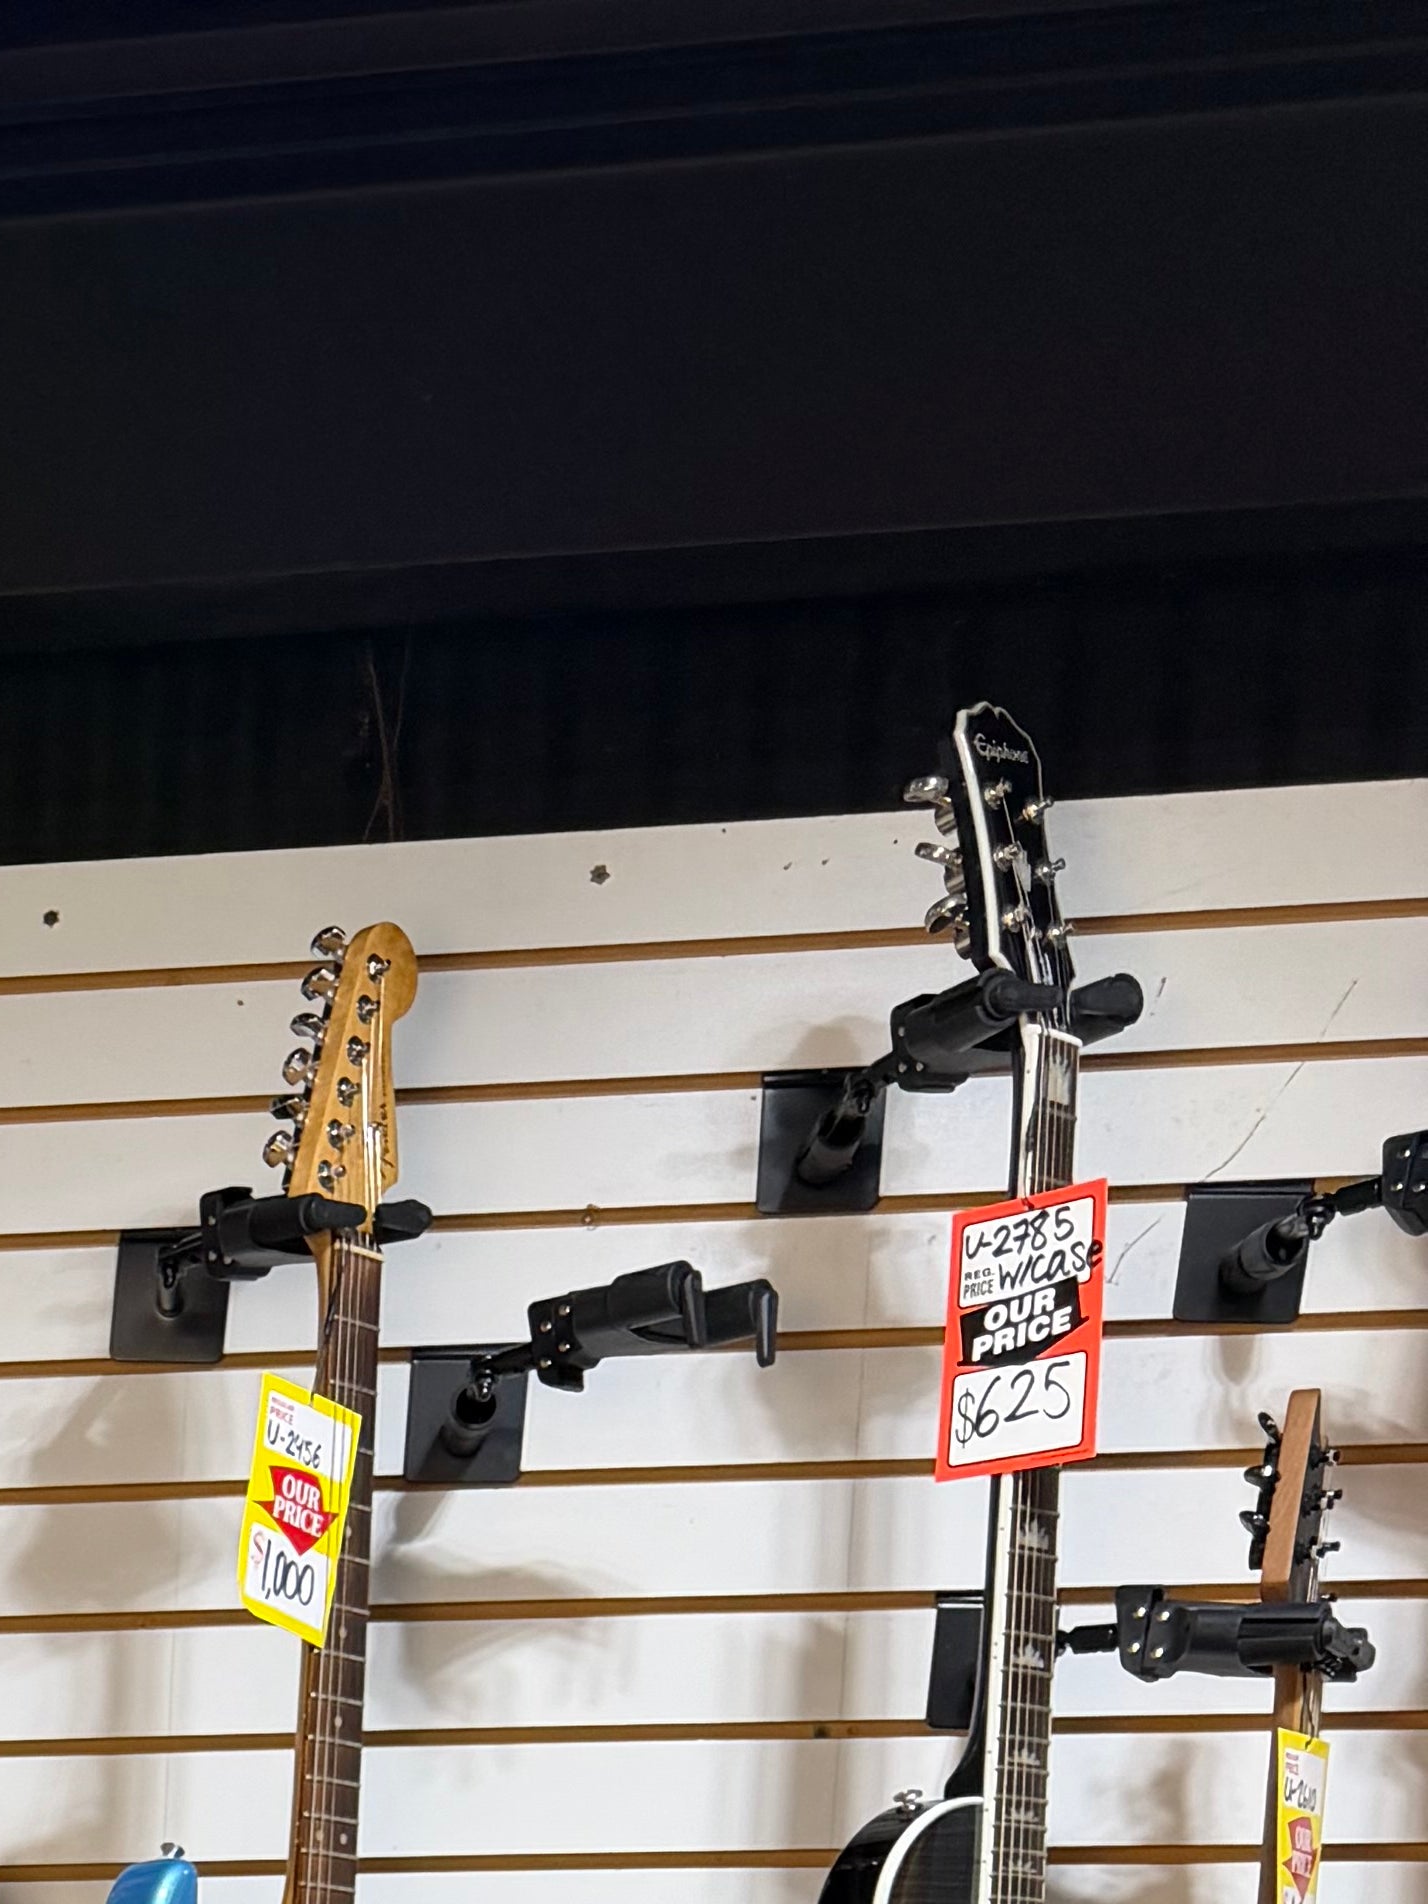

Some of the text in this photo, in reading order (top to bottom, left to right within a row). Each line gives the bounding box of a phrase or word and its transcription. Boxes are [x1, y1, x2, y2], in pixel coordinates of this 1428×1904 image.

[965, 1205, 1075, 1260] U-2785
[963, 1279, 994, 1300] PRICE
[964, 1266, 996, 1281] REG.
[983, 1287, 1056, 1331] OUR
[971, 1305, 1073, 1363] PRICE
[269, 1404, 295, 1425] PRICE
[955, 1360, 1072, 1449] $625
[281, 1474, 321, 1512] OUR
[273, 1498, 324, 1538] PRICE
[251, 1530, 315, 1606] $1,000
